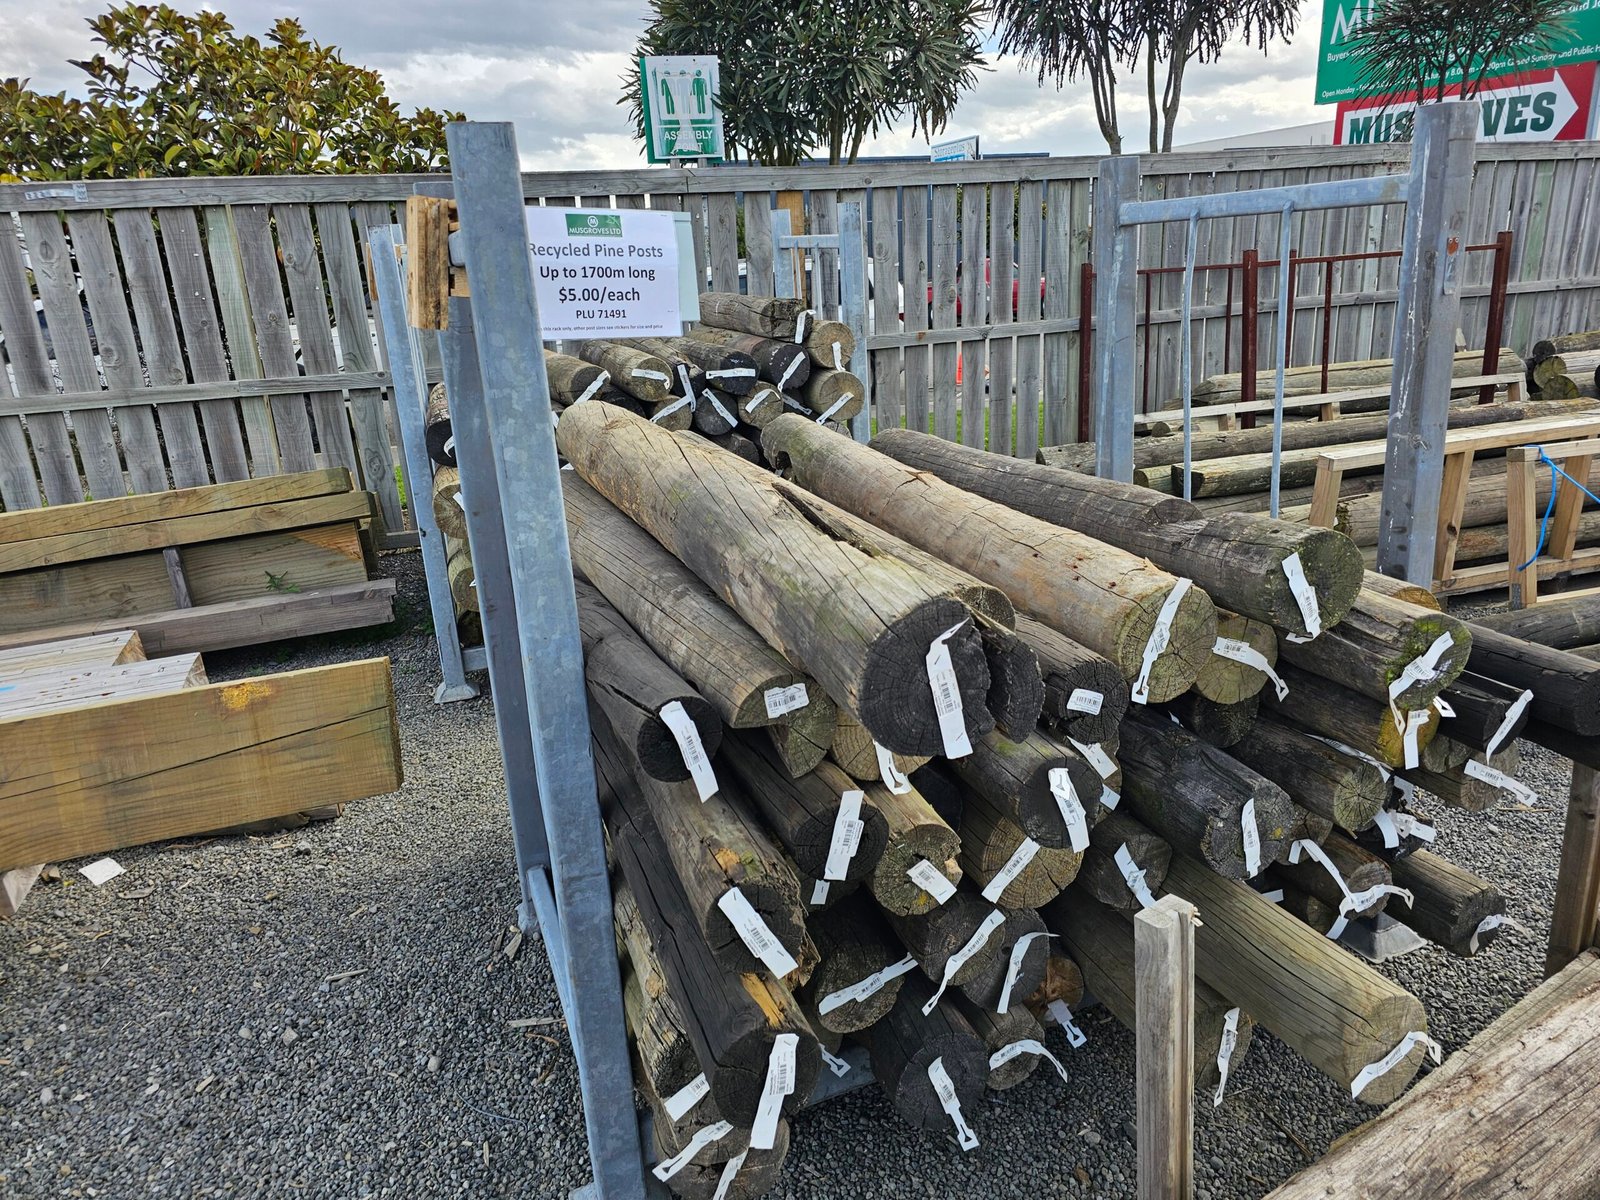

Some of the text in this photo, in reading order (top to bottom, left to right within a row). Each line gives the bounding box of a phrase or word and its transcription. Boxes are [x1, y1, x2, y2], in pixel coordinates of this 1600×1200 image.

[1322, 89, 1337, 98] Open
[1336, 85, 1355, 95] Monday
[1531, 50, 1557, 63] Sunday
[1573, 45, 1594, 56] Public
[529, 243, 663, 259] Recycled Pine Posts
[540, 266, 656, 281] Up to 1700m long
[559, 286, 641, 304] $5.00/each
[576, 310, 627, 319] PLU 71491
